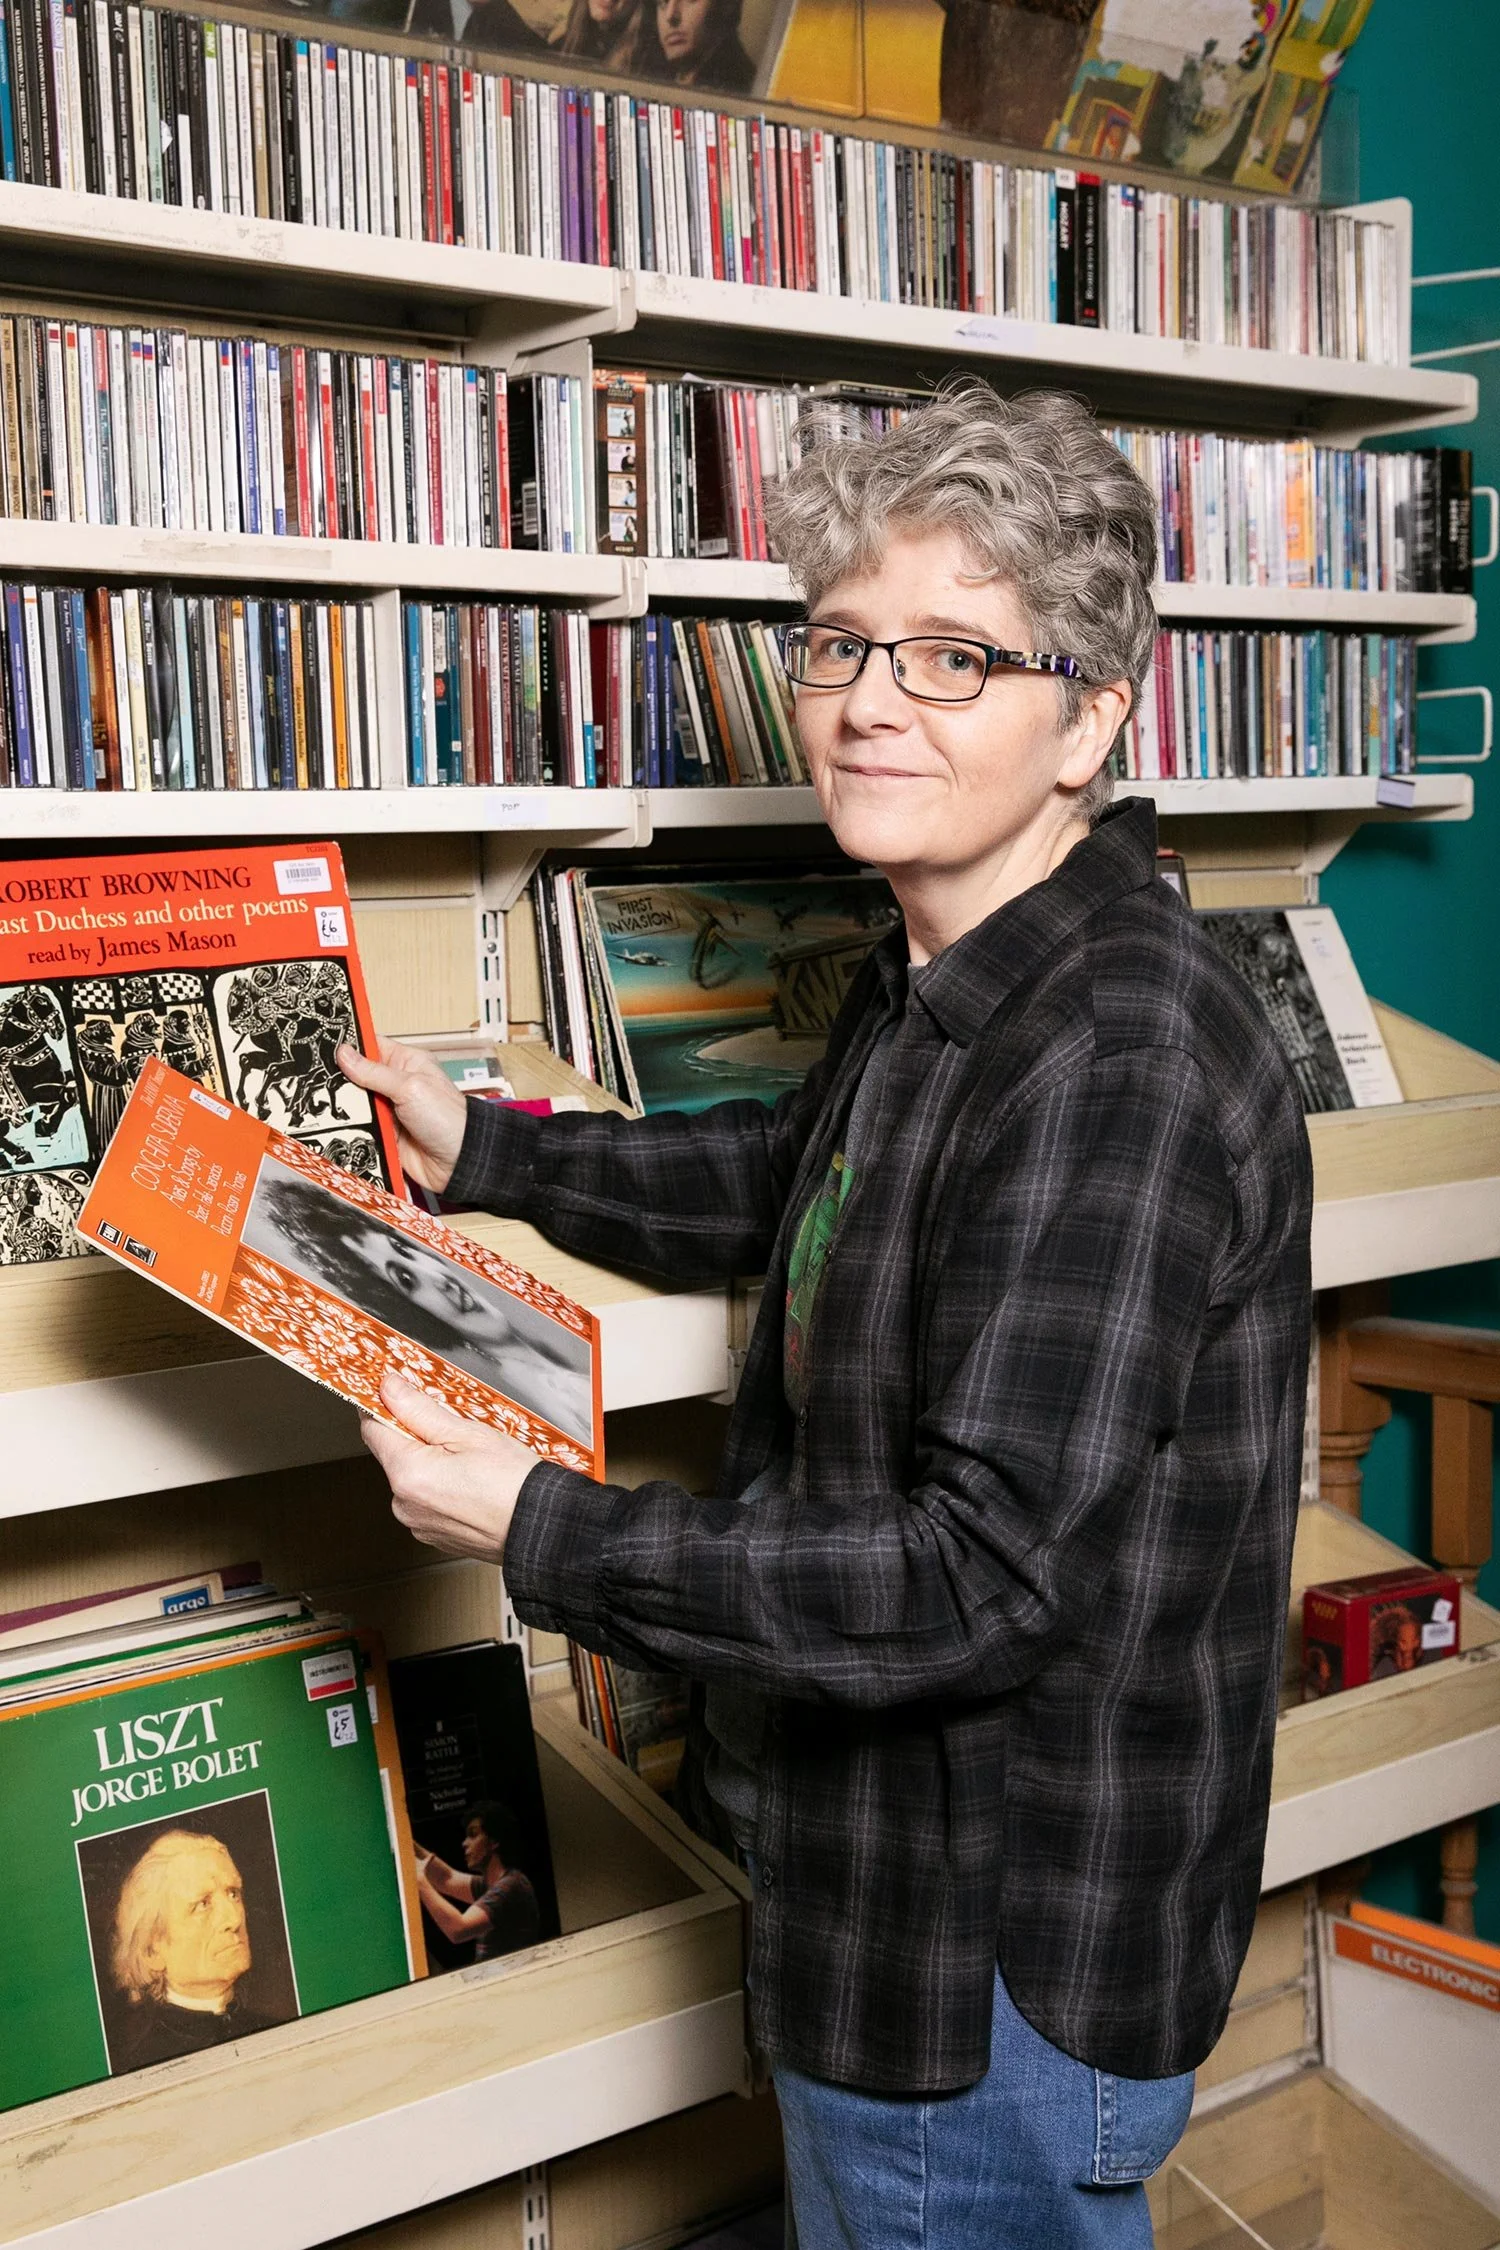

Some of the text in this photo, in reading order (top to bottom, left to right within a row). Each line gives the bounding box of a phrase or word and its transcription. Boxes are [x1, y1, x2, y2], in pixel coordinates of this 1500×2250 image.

[102, 866, 252, 897] BROWNING
[0, 896, 309, 935] ast Duchess and other poems
[606, 910, 673, 935] INVASION
[616, 897, 653, 914] FIRST
[27, 929, 237, 967] read by James Mason
[130, 1133, 173, 1191] CONCHITA
[309, 1662, 350, 1680] INSTRUMENTAL
[93, 1697, 224, 1772] LISZT
[70, 1740, 263, 1827] JORGE BOLET
[1371, 1943, 1499, 2004] ELECTRONIC
